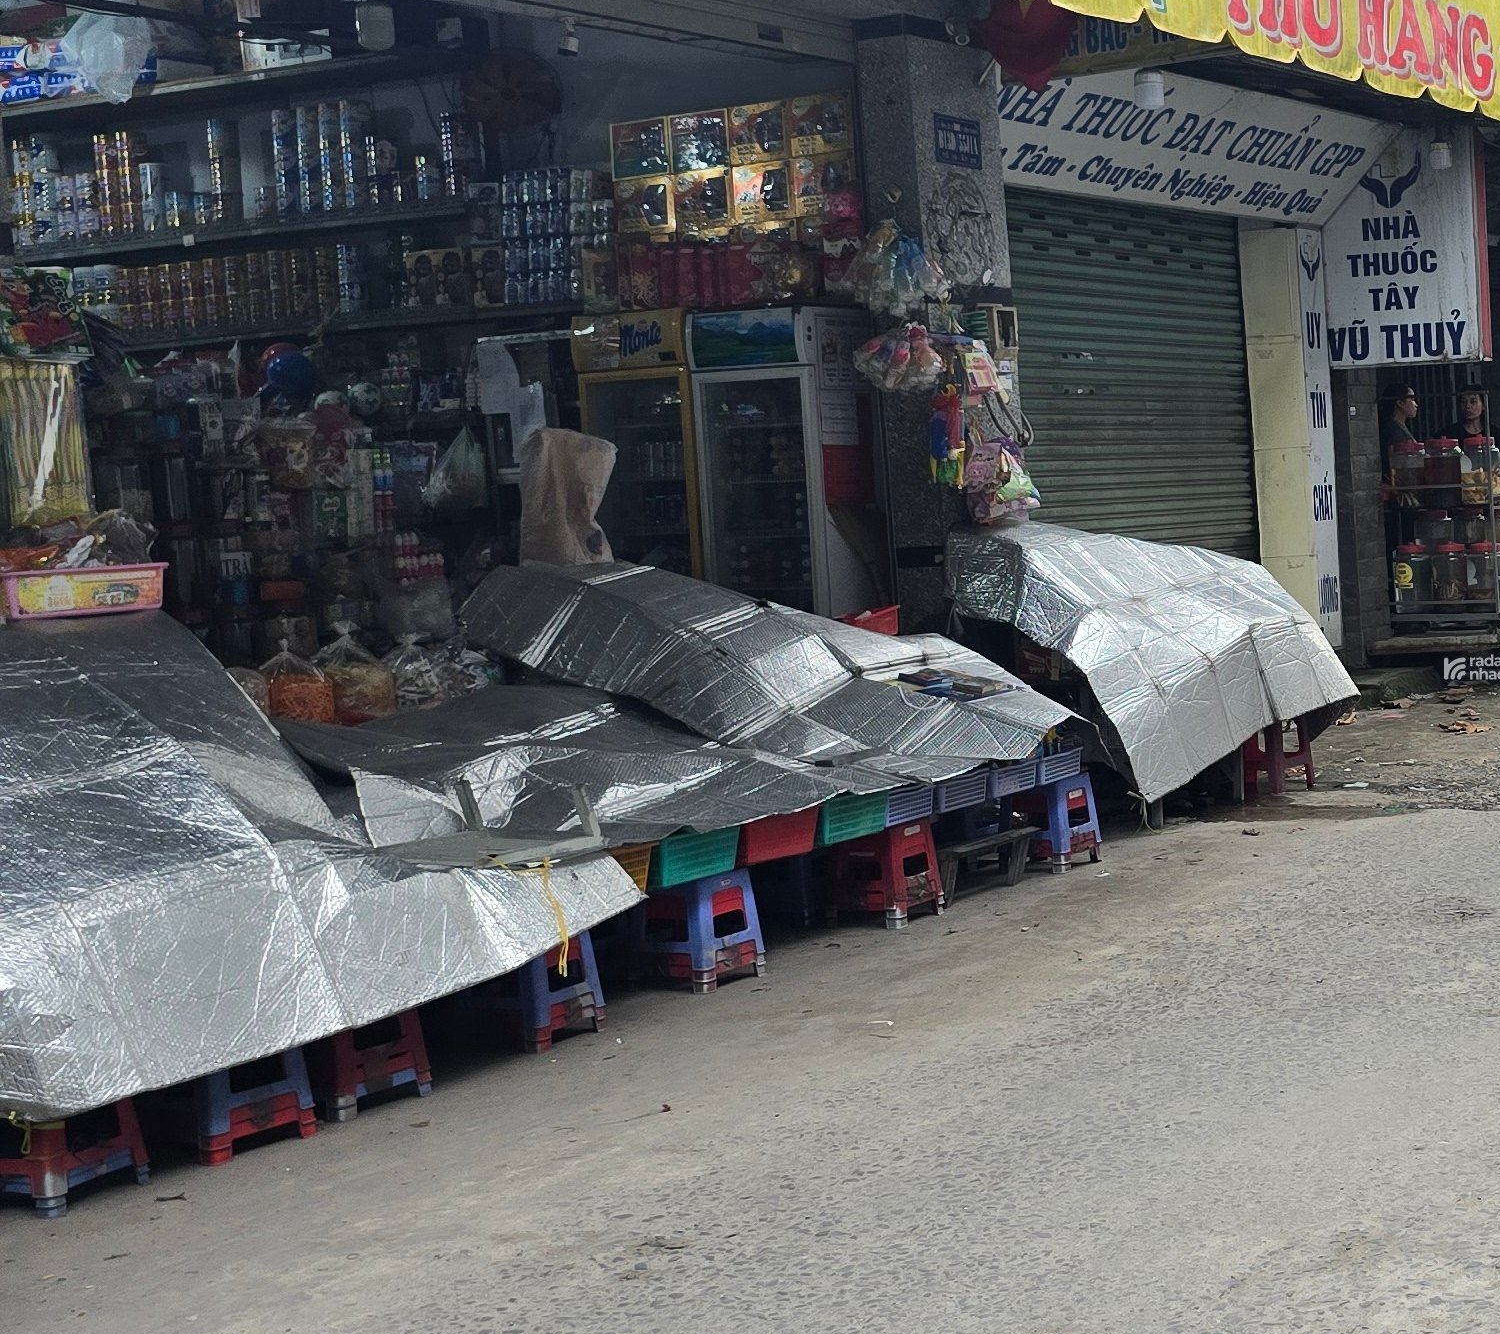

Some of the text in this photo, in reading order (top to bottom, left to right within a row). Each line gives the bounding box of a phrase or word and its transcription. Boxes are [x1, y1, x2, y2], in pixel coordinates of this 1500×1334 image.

[997, 78, 1072, 127] NHÀ
[1162, 113, 1236, 161] ĐẠT
[1226, 115, 1322, 171] CHUẨN
[1310, 142, 1366, 178] GPP
[1008, 142, 1066, 176] Tâm
[1078, 154, 1163, 192] Chuyên
[1160, 168, 1235, 206] Nghiệp
[1240, 181, 1289, 212] Hiệu
[1362, 210, 1421, 241] NHÀ
[1347, 242, 1438, 277] THUỐC
[1368, 282, 1420, 311] TÂY
[1306, 312, 1321, 349] UY
[1328, 309, 1466, 361] VŨ THUỶ
[1310, 384, 1327, 428] TÍN
[1313, 471, 1333, 522] CHẤT
